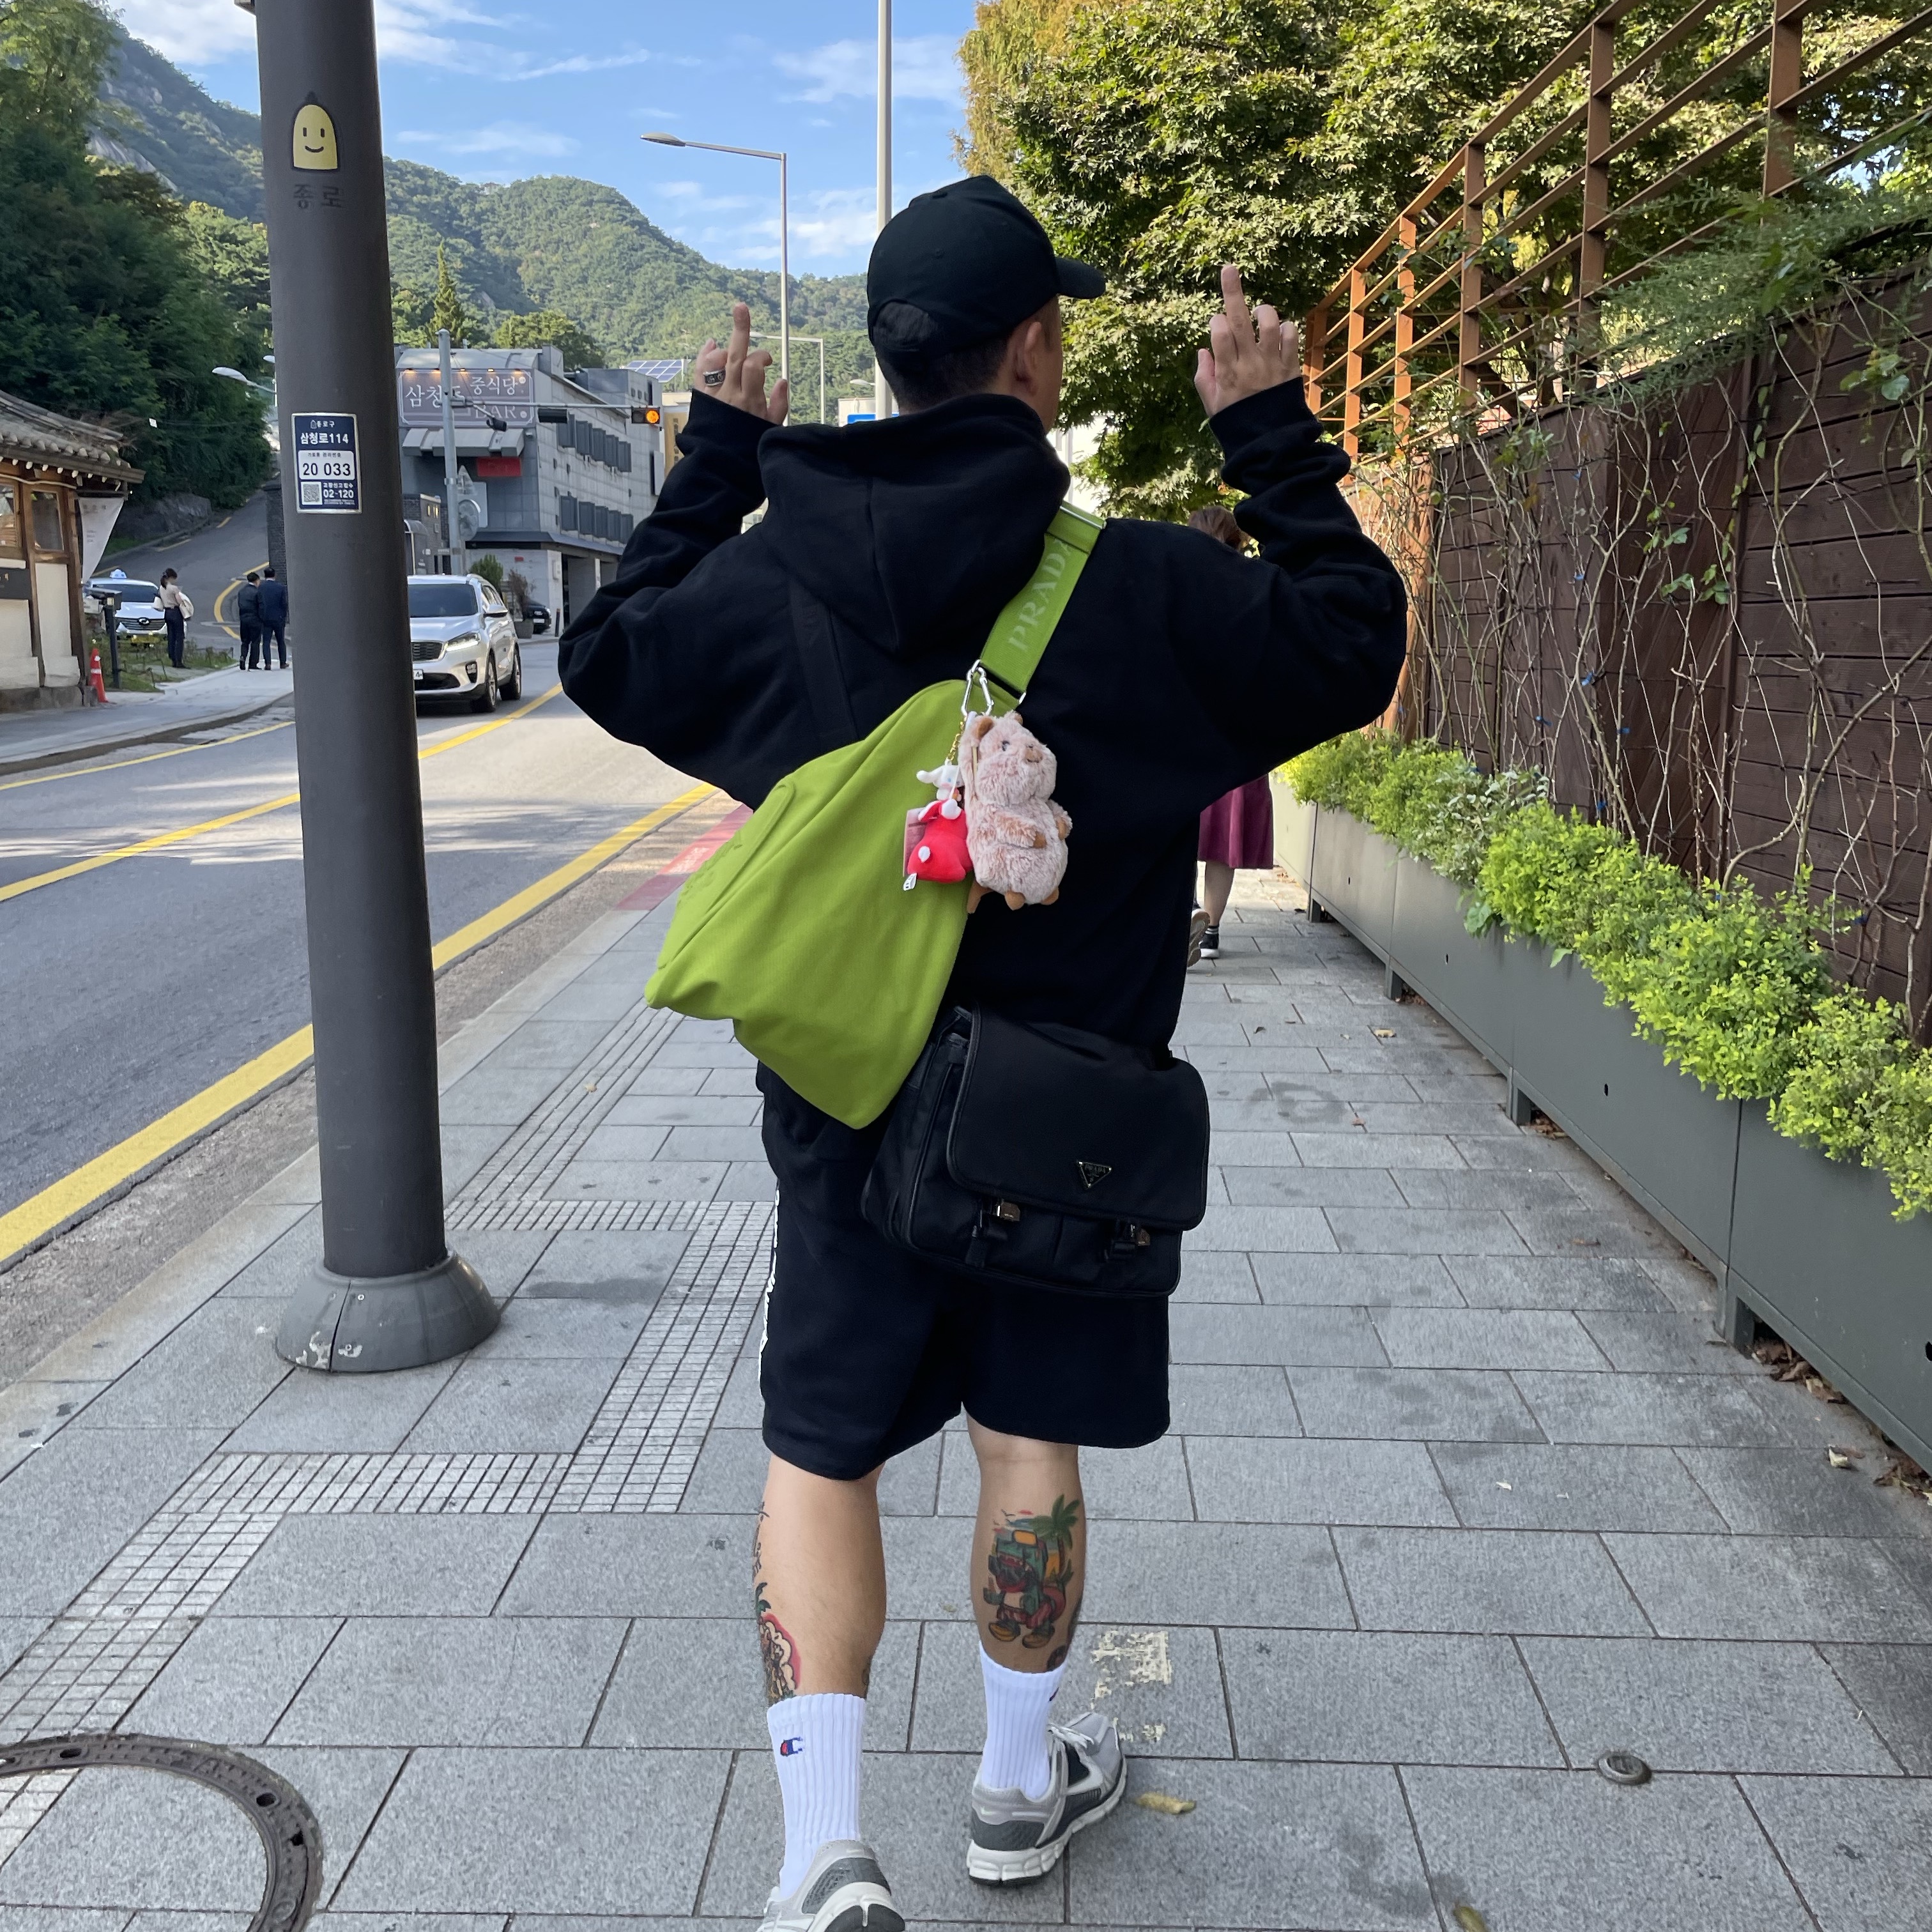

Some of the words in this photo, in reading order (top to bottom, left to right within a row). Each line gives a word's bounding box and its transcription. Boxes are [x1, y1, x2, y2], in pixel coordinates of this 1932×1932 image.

[470, 376, 518, 395] 중식당
[303, 463, 318, 476] 20
[323, 463, 351, 476] 033
[323, 489, 354, 498] 02-120
